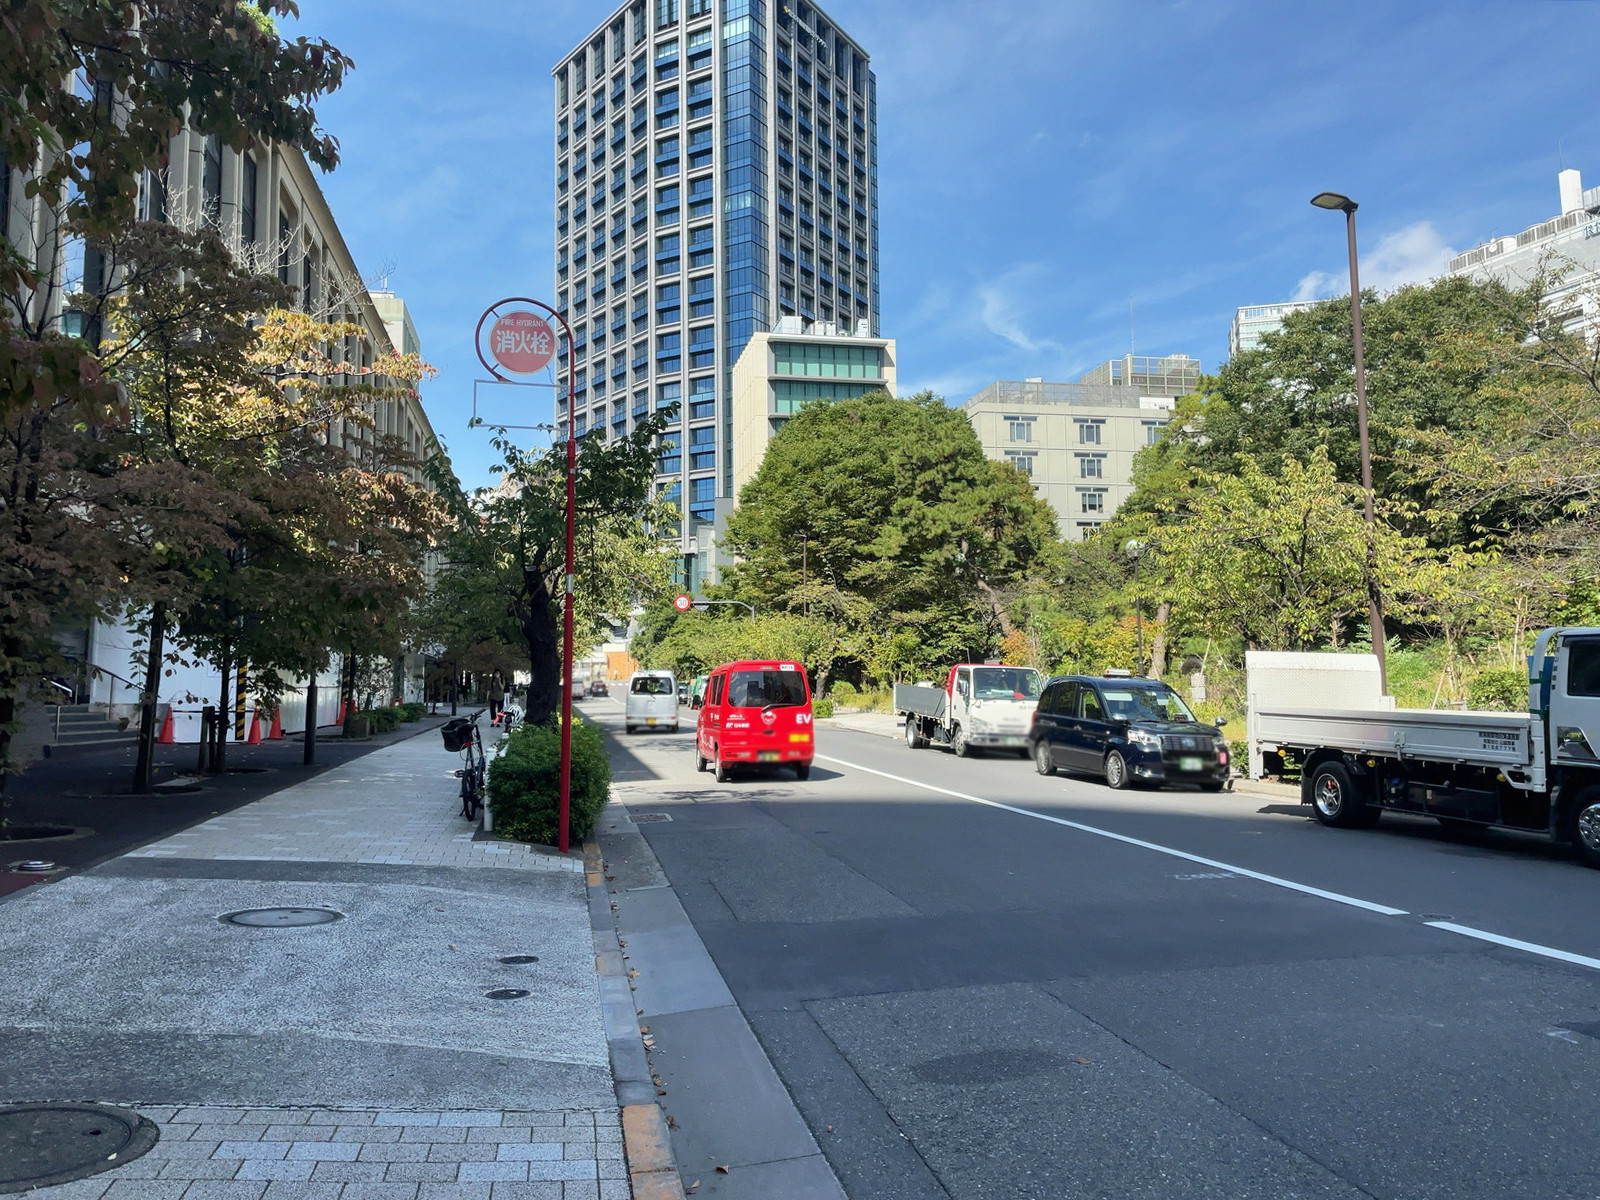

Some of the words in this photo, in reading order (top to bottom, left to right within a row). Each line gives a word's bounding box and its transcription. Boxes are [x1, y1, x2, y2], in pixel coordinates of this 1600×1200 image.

[496, 330, 550, 355] 消火栓
[678, 599, 687, 607] 30
[796, 713, 812, 724] EV
